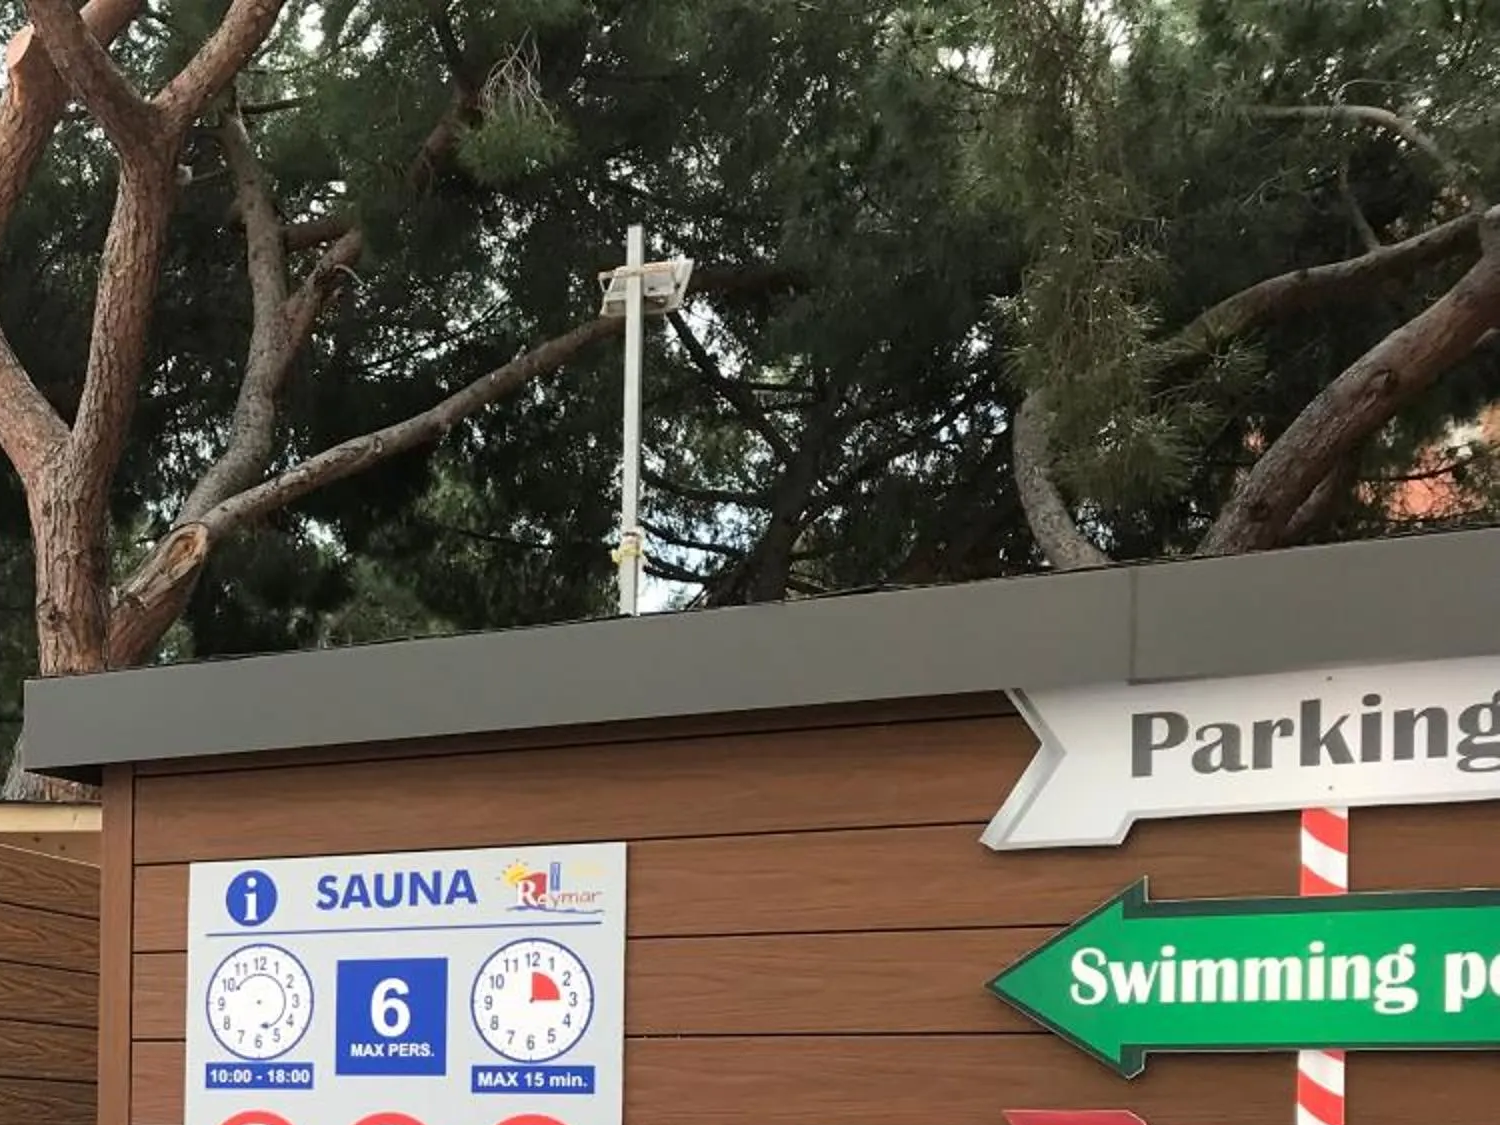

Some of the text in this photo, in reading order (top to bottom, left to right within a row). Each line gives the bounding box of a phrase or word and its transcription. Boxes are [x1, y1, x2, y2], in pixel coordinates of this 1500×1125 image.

[1131, 689, 1500, 777] Parking
[315, 869, 478, 910] SAUNA
[254, 956, 267, 971] 12
[504, 958, 518, 973] 11
[525, 952, 540, 967] 12
[549, 957, 555, 971] 1
[235, 963, 248, 976] 11
[274, 961, 279, 974] 1
[286, 974, 294, 988] 2
[489, 974, 504, 989] 10
[562, 971, 571, 986] 2
[1070, 940, 1500, 1014] Swimming p
[223, 978, 236, 992] 10
[218, 996, 226, 1010] 9
[292, 994, 300, 1008] 3
[484, 995, 492, 1010] 9
[569, 992, 578, 1007] 3
[371, 978, 411, 1037] 6
[224, 1016, 231, 1030] 8
[286, 1014, 294, 1027] 4
[490, 1016, 499, 1030] 8
[562, 1014, 571, 1028] 4
[238, 1030, 245, 1044] 7
[255, 1034, 262, 1048] 6
[273, 1028, 281, 1042] 5
[507, 1031, 515, 1044] 7
[547, 1028, 556, 1043] 5
[526, 1035, 535, 1050] 6
[351, 1043, 434, 1058] MAX PERS.
[210, 1069, 252, 1082] 10:00
[267, 1069, 310, 1082] 18:00
[477, 1072, 588, 1087] MAX 15 min.
